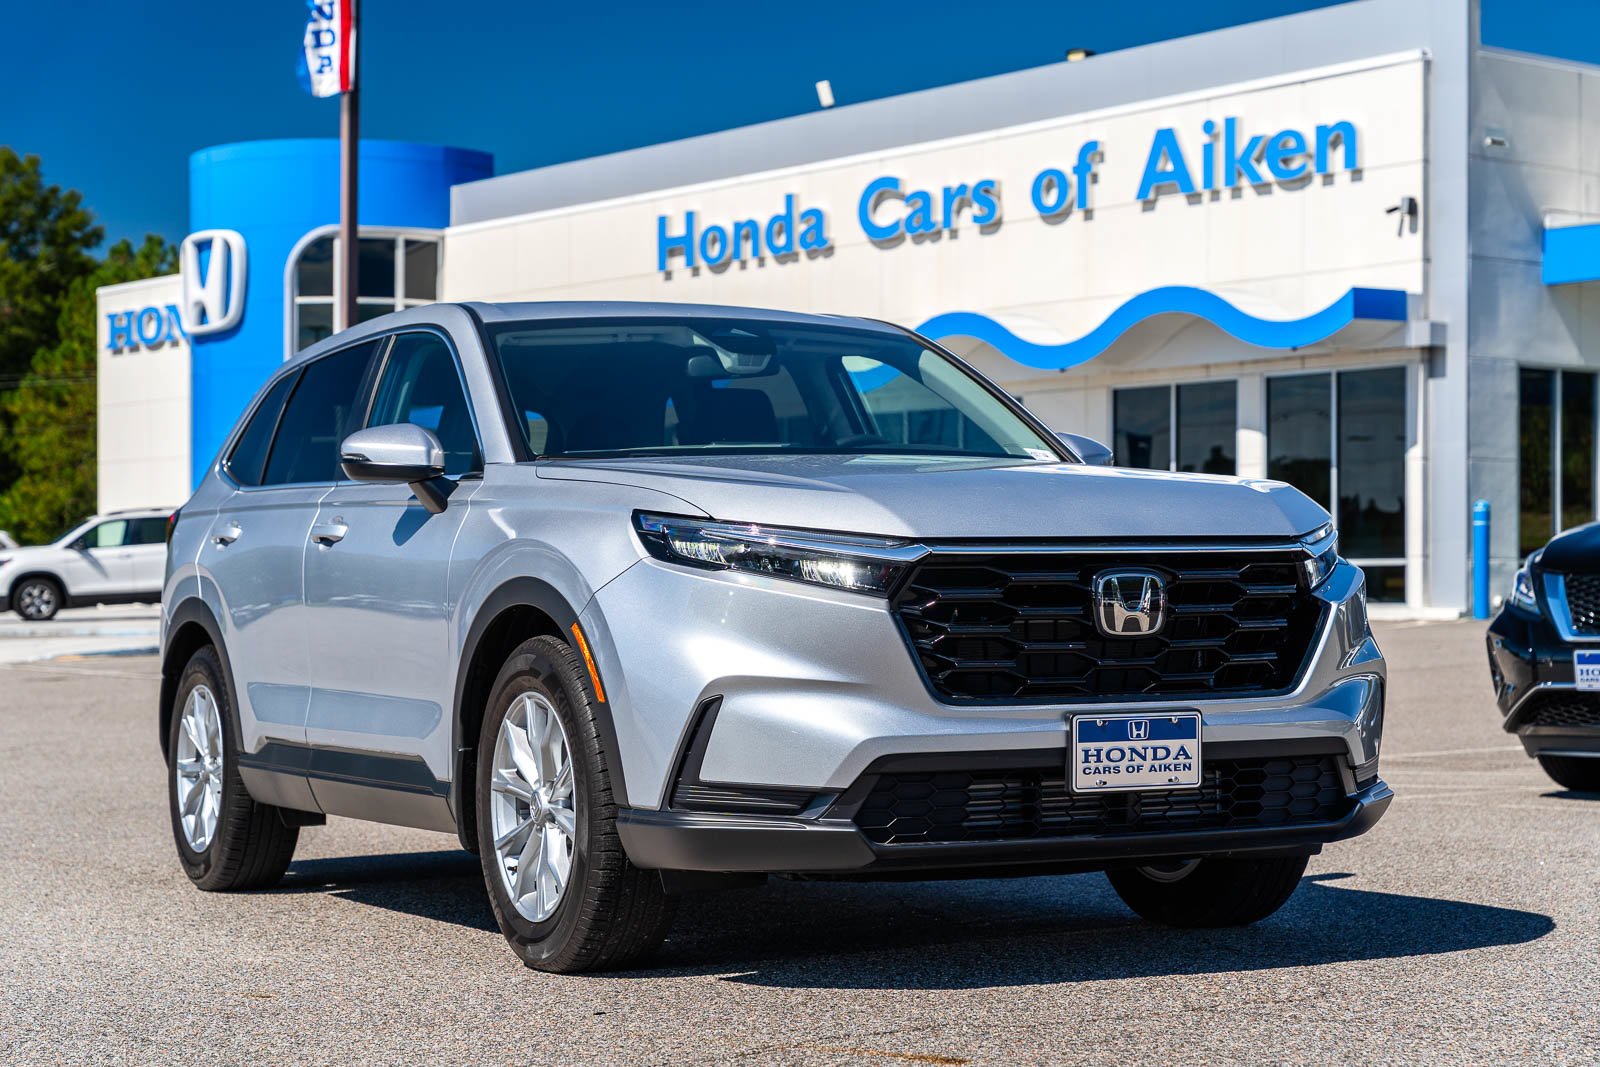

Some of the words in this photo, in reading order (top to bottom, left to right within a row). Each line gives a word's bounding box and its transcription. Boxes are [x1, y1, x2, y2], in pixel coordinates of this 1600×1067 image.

[657, 193, 829, 272] Honda
[858, 176, 997, 241] Cars
[1031, 140, 1099, 216] of
[1136, 117, 1357, 201] Aiken
[1081, 744, 1193, 764] HONDA
[1082, 765, 1121, 776] CARS
[1125, 764, 1144, 774] OF
[1148, 762, 1192, 773] AIKEN
